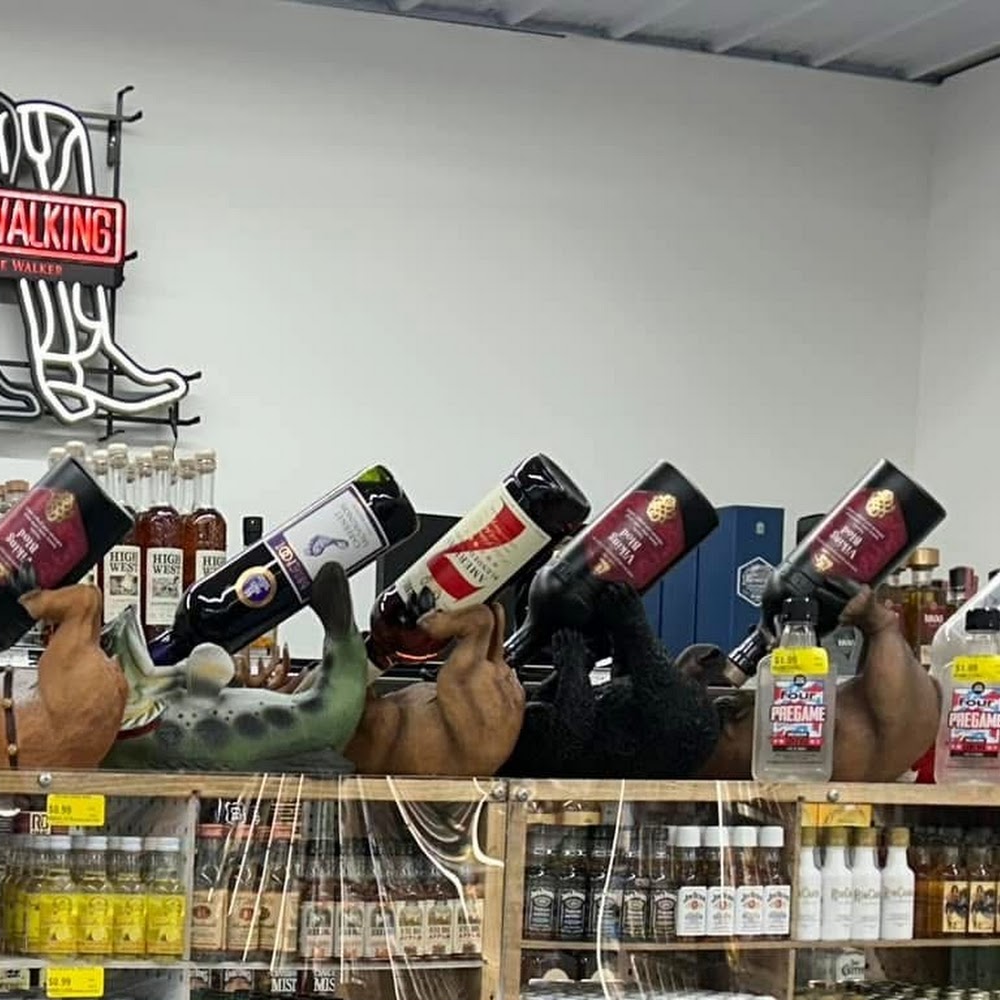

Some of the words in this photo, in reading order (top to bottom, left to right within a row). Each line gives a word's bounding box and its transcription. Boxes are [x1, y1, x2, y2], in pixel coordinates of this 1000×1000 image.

[12, 260, 64, 276] WALKER
[771, 704, 827, 723] PREGAME
[271, 977, 297, 992] MIST
[313, 977, 336, 992] MIS
